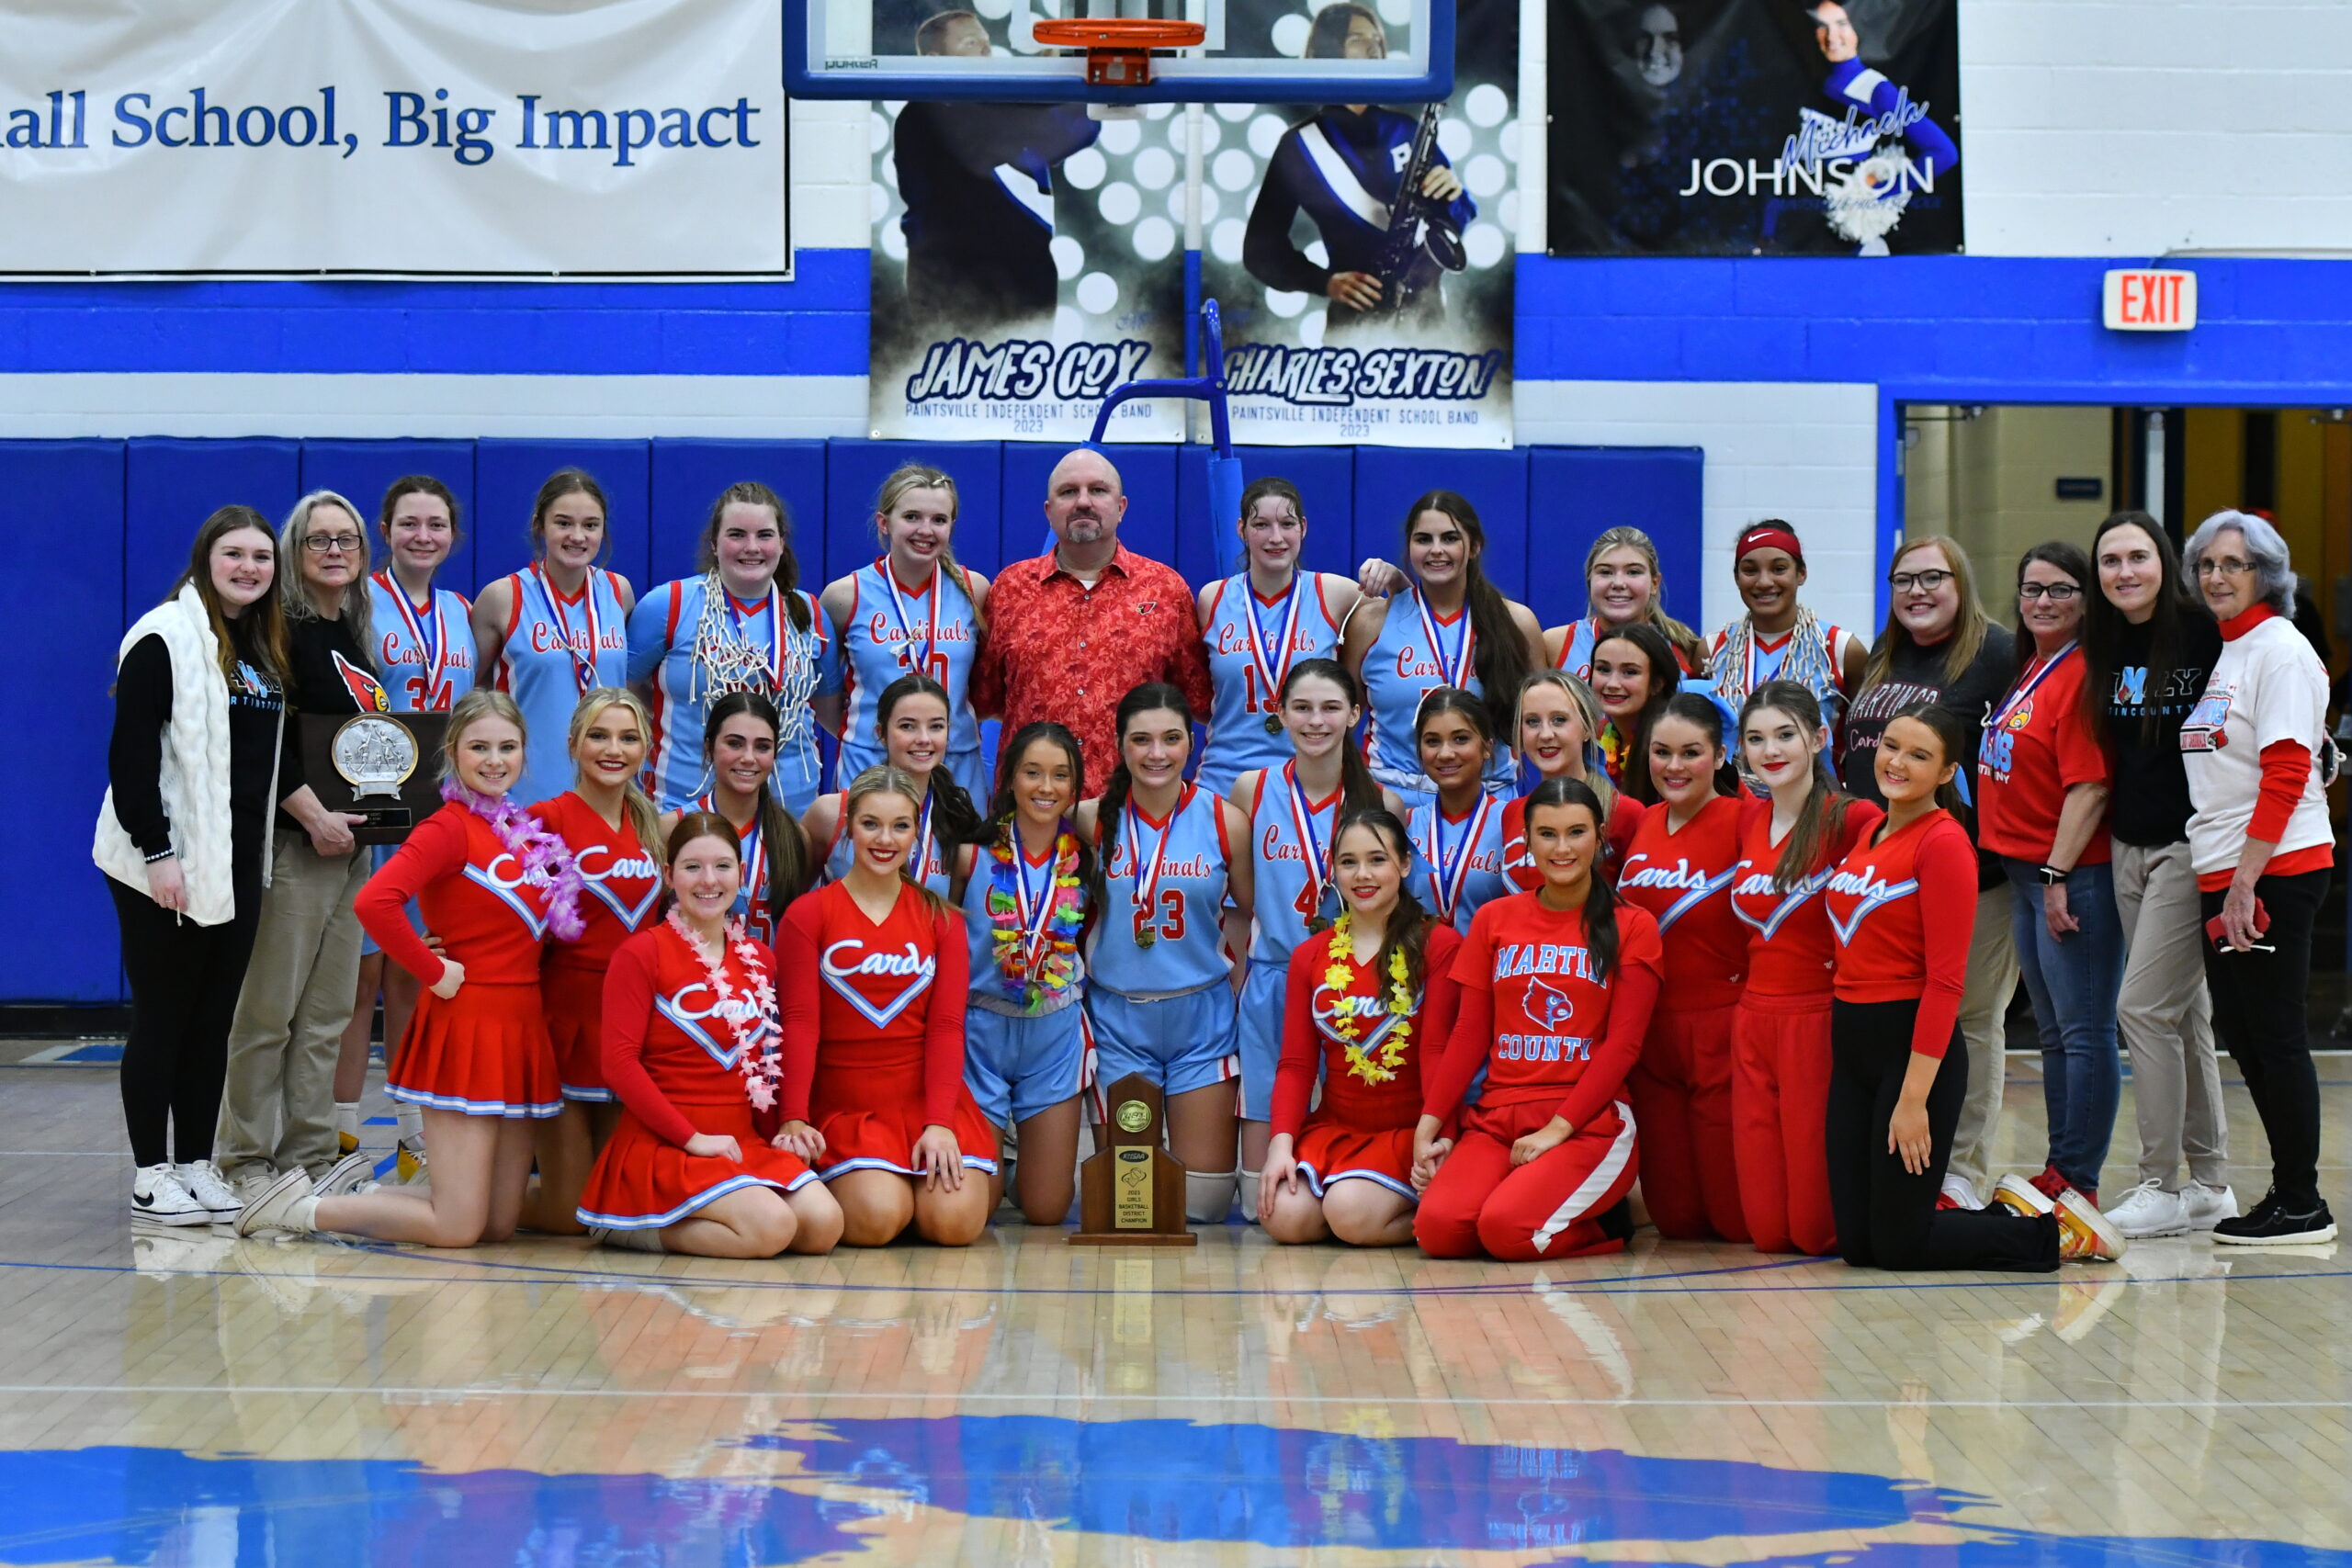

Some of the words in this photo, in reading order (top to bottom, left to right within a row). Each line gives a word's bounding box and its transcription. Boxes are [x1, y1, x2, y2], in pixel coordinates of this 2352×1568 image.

[0, 90, 88, 149] all
[111, 85, 358, 159] School,
[382, 87, 496, 166] Big
[515, 96, 761, 166] Impact
[1781, 85, 1930, 178] Michaela
[1679, 156, 1934, 197] JOHNSON
[2120, 274, 2185, 324] EXIT
[906, 338, 1055, 402] JAMES
[1056, 339, 1152, 400] COX
[1224, 343, 1360, 406] CHARLES
[1354, 349, 1503, 400] SEXTON
[906, 403, 978, 418] PAINTSVILLE
[985, 404, 1064, 420] INDEPENDENT
[1121, 403, 1152, 419] BAND
[1013, 419, 1044, 434] 2023
[1232, 405, 1305, 422] PAINTSVILLE
[1311, 407, 1391, 424] INDEPENDENT
[1398, 409, 1442, 425] SCHOOL
[1448, 410, 1479, 425] BAND
[1340, 424, 1371, 438] 2023
[1618, 853, 1711, 891] Cards
[1131, 888, 1186, 942] 23
[820, 938, 937, 977] Cards
[1498, 1033, 1593, 1062] COUNTY
